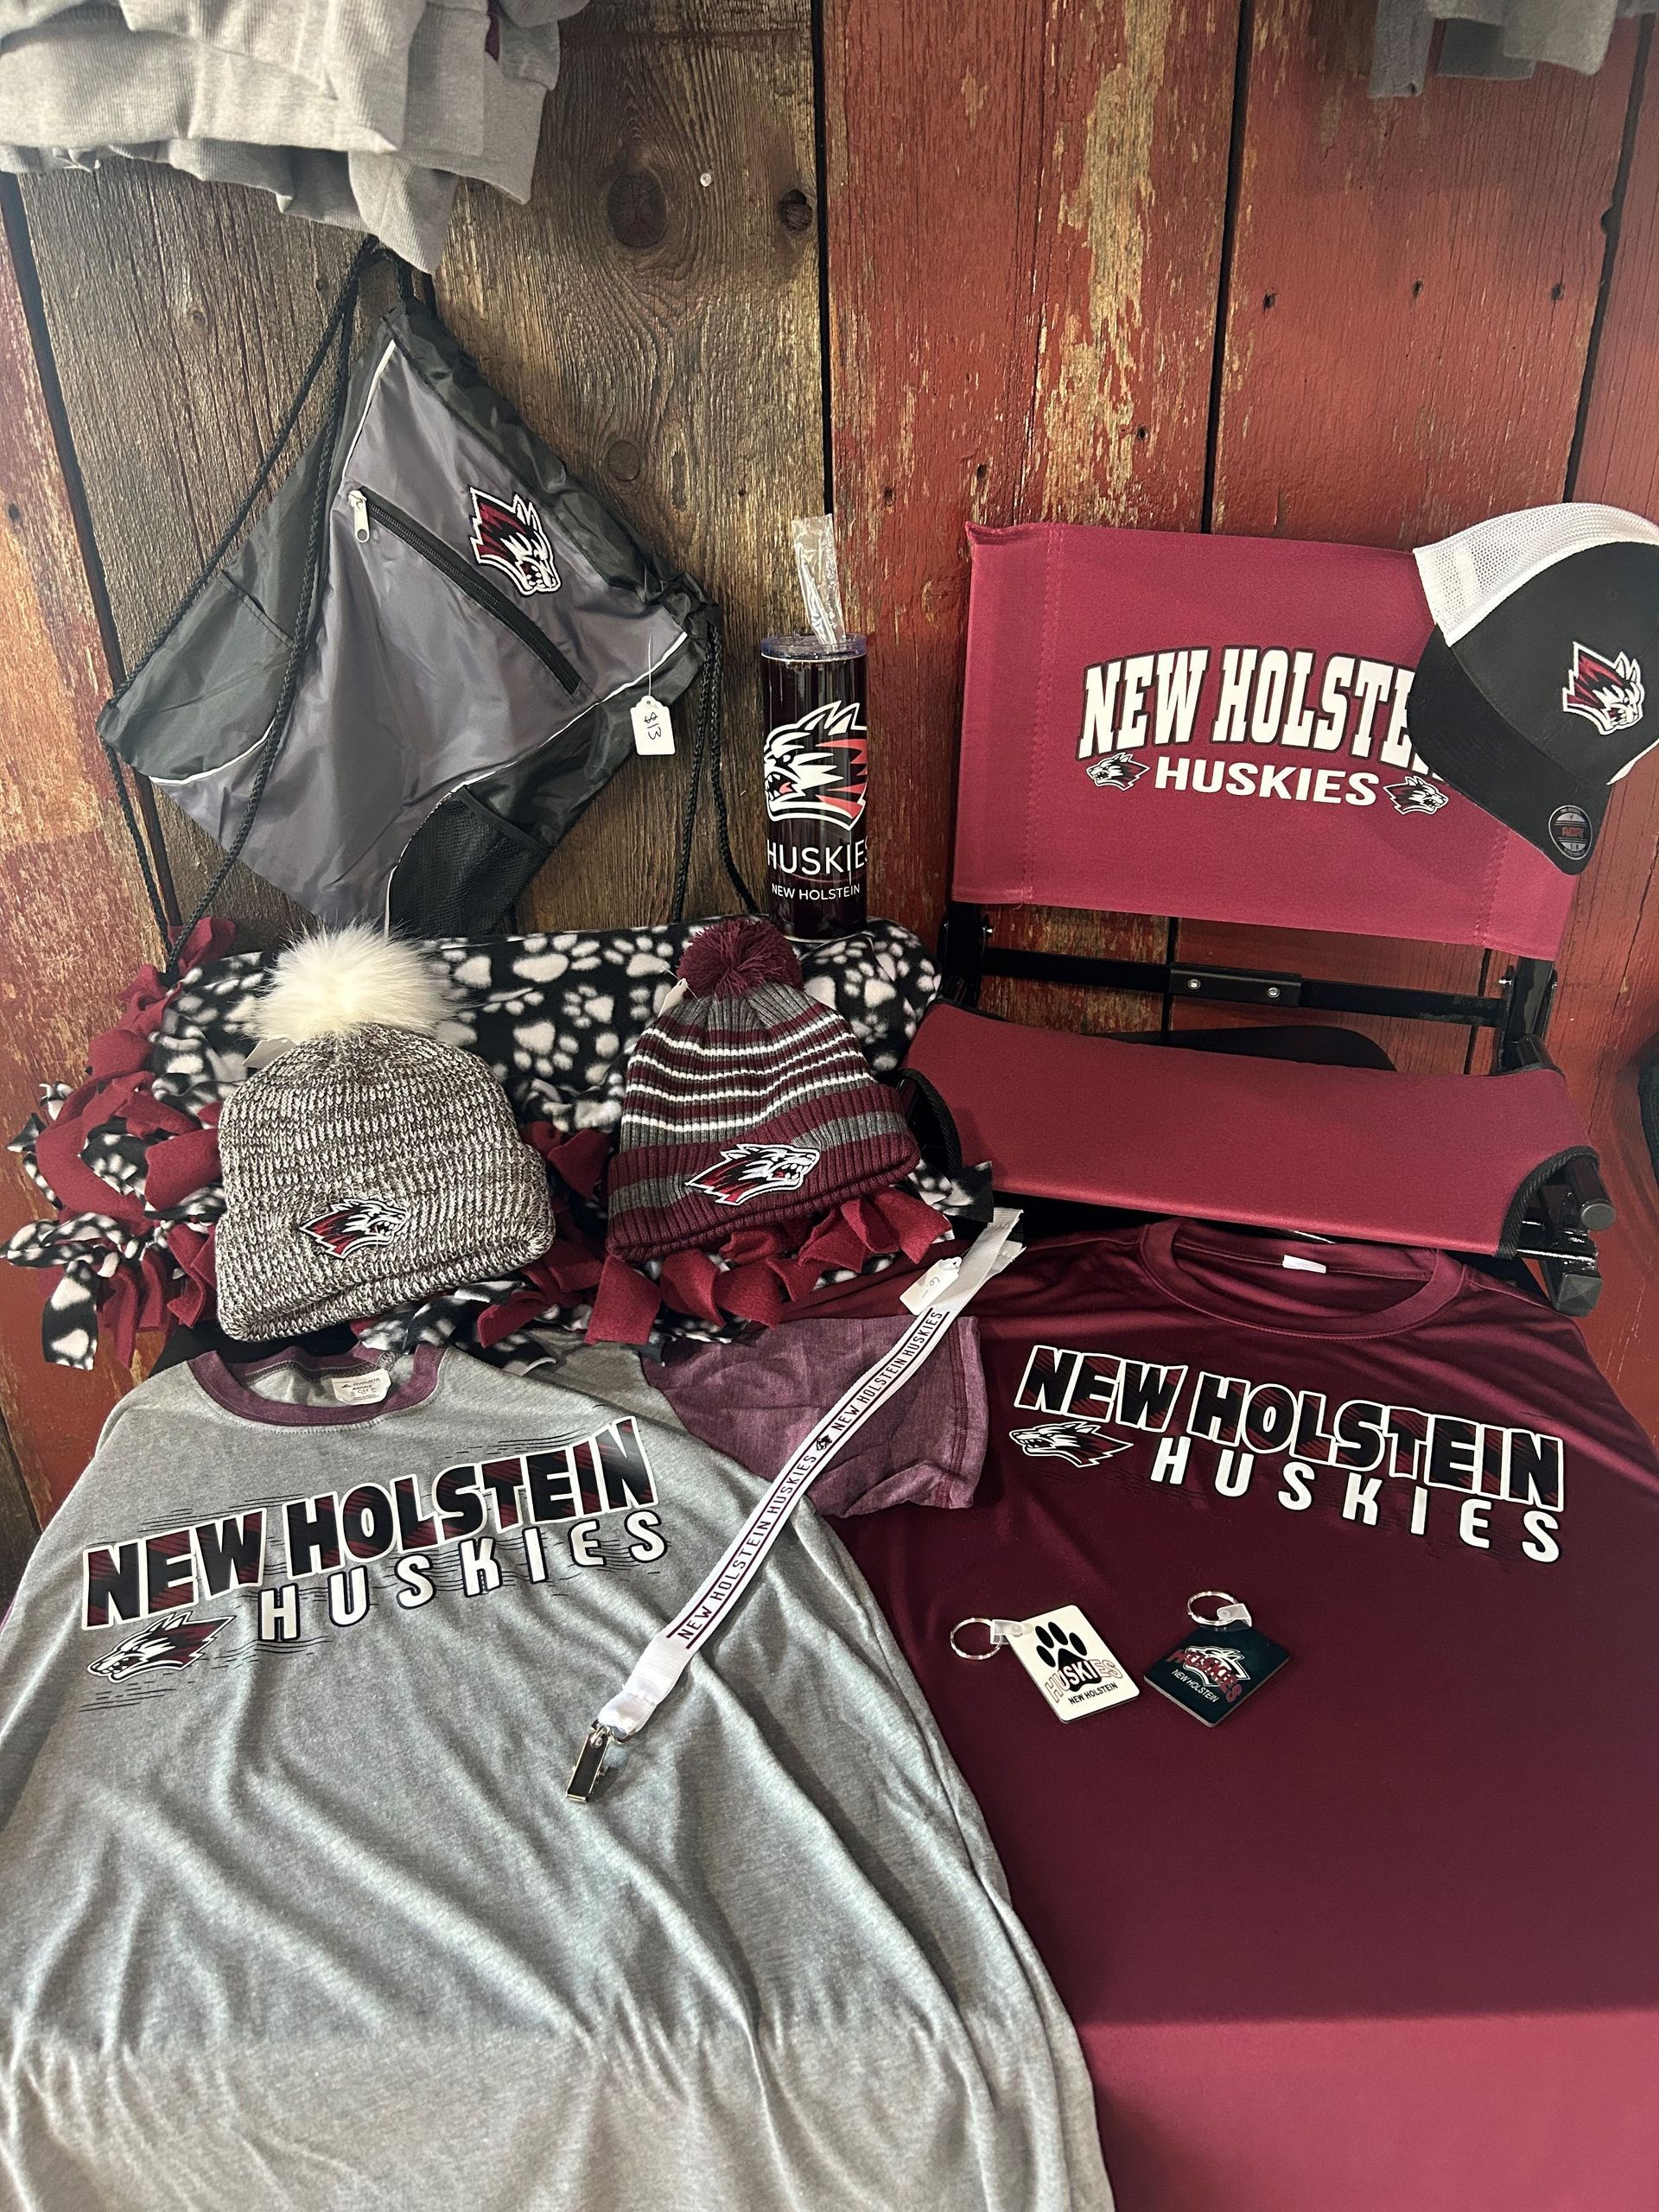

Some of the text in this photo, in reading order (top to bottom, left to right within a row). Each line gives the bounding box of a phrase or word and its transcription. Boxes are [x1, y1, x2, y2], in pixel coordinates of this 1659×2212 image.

[1077, 647, 1444, 781] NEW HOLSTE
[1155, 756, 1377, 805] HUSKIES
[767, 836, 868, 875] HUSKIE
[772, 883, 860, 900] NEW HOLSTEIN
[831, 1312, 943, 1431] NEW HOLSTEIN HUSKIES
[1014, 1345, 1564, 1512] NEW HOLSTEIN
[81, 1415, 659, 1630] NEW HOLSTEIN
[677, 1455, 817, 1640] NEW HOLSTEIN HUSKIES
[1150, 1436, 1560, 1563] HUSKIES
[259, 1510, 668, 1643] HUSKIES
[1045, 1659, 1123, 1703] HUSKIES
[1068, 1681, 1118, 1705] NEW HOLSTEIN
[1172, 1669, 1220, 1702] NEW HOLSTEIN
